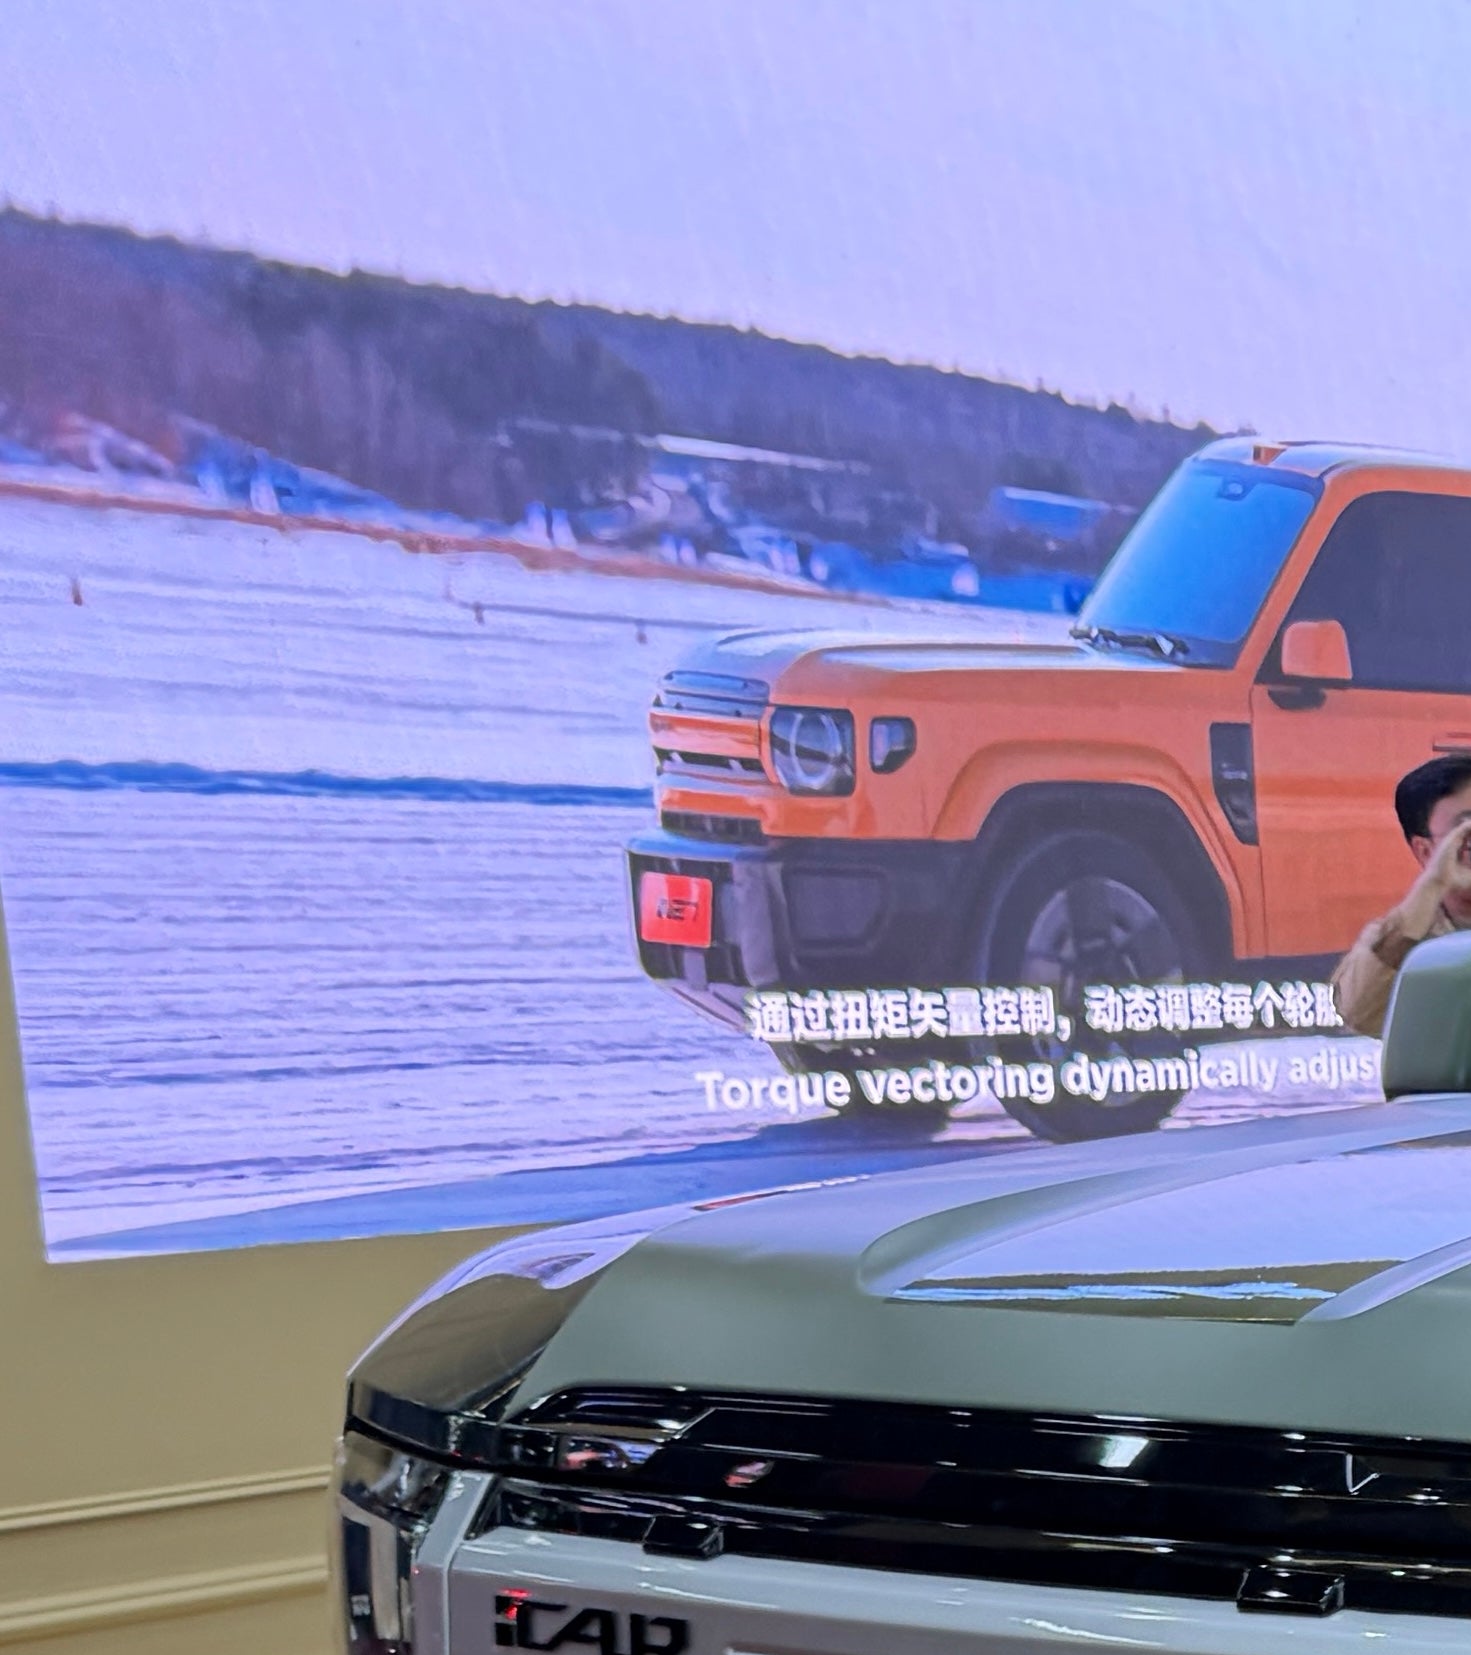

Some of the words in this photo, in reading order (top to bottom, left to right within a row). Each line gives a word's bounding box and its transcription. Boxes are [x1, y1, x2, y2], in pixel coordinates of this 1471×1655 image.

[695, 1069, 851, 1114] Torque
[856, 1055, 1055, 1105] vectoring
[1060, 1047, 1278, 1101] dynamically
